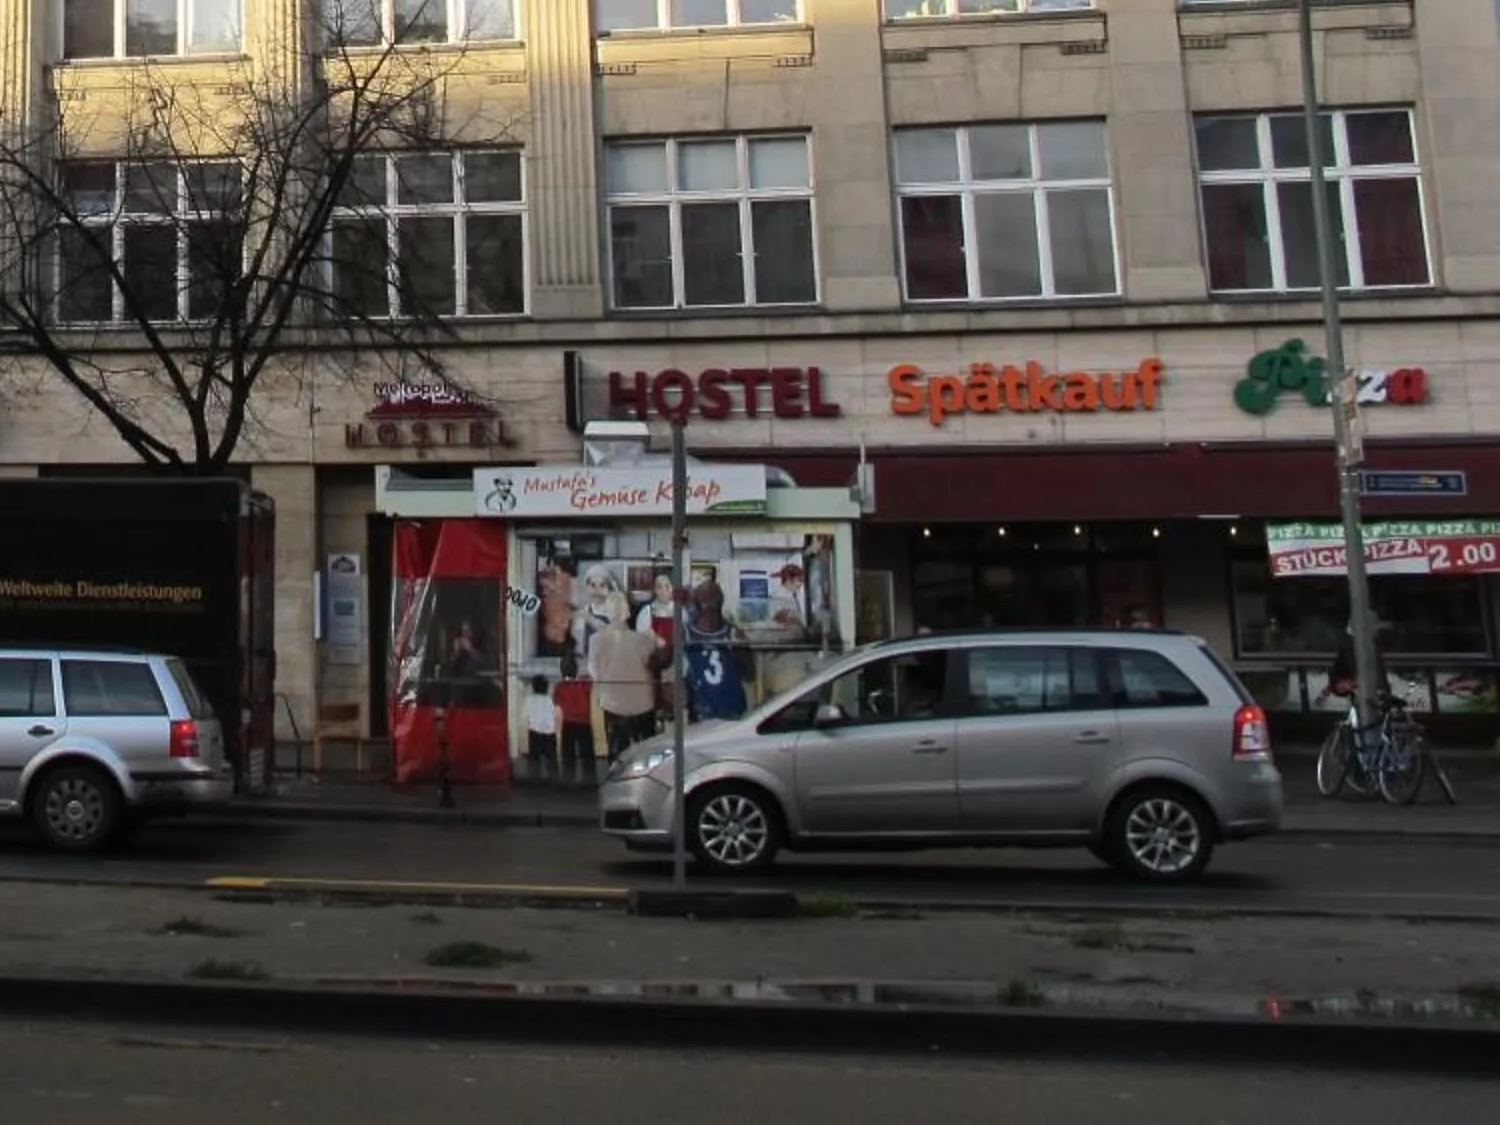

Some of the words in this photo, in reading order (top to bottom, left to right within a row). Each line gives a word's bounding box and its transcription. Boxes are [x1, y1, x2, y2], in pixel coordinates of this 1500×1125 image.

[610, 367, 839, 417] HOSTEL
[887, 357, 1164, 424] Spätkauf
[345, 421, 518, 448] HOSTEL
[523, 472, 596, 495] Mustafa's
[570, 486, 648, 510] Gemüse
[655, 475, 721, 504] Kbap
[1426, 522, 1476, 534] PIZZA
[1275, 547, 1347, 573] STÜCK
[77, 581, 203, 603] Dienstleistungen
